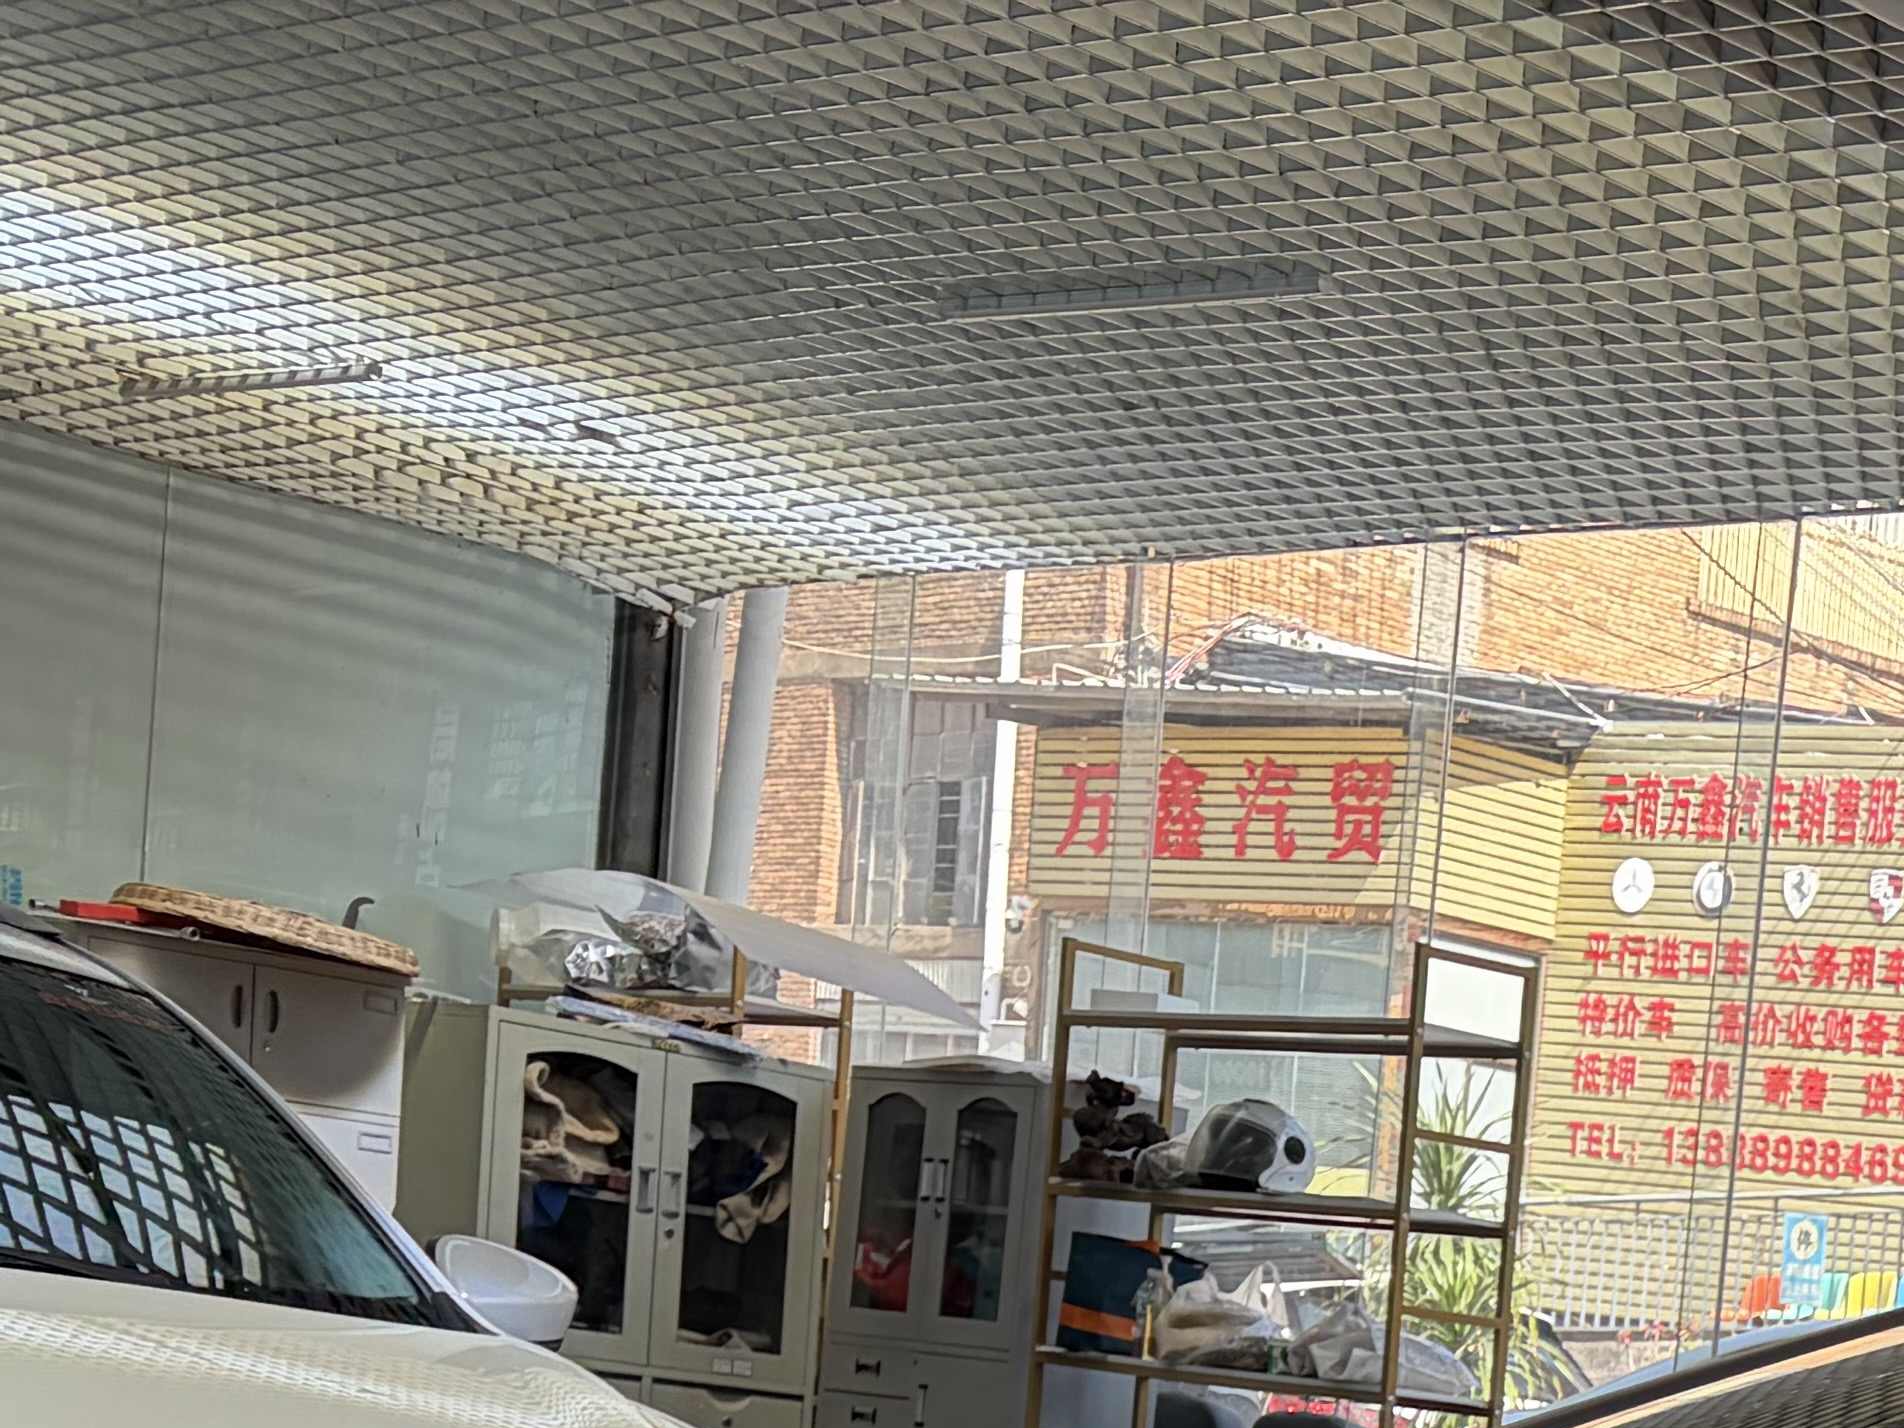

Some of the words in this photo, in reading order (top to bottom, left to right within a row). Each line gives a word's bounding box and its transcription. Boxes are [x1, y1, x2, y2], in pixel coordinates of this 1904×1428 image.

[1055, 755, 1395, 862] 万鑫汽贸
[1583, 932, 1750, 984] 平行进口车
[1578, 993, 1675, 1041] 特价车
[1572, 1050, 1637, 1098] 抵押
[1665, 1058, 1732, 1103] 质保
